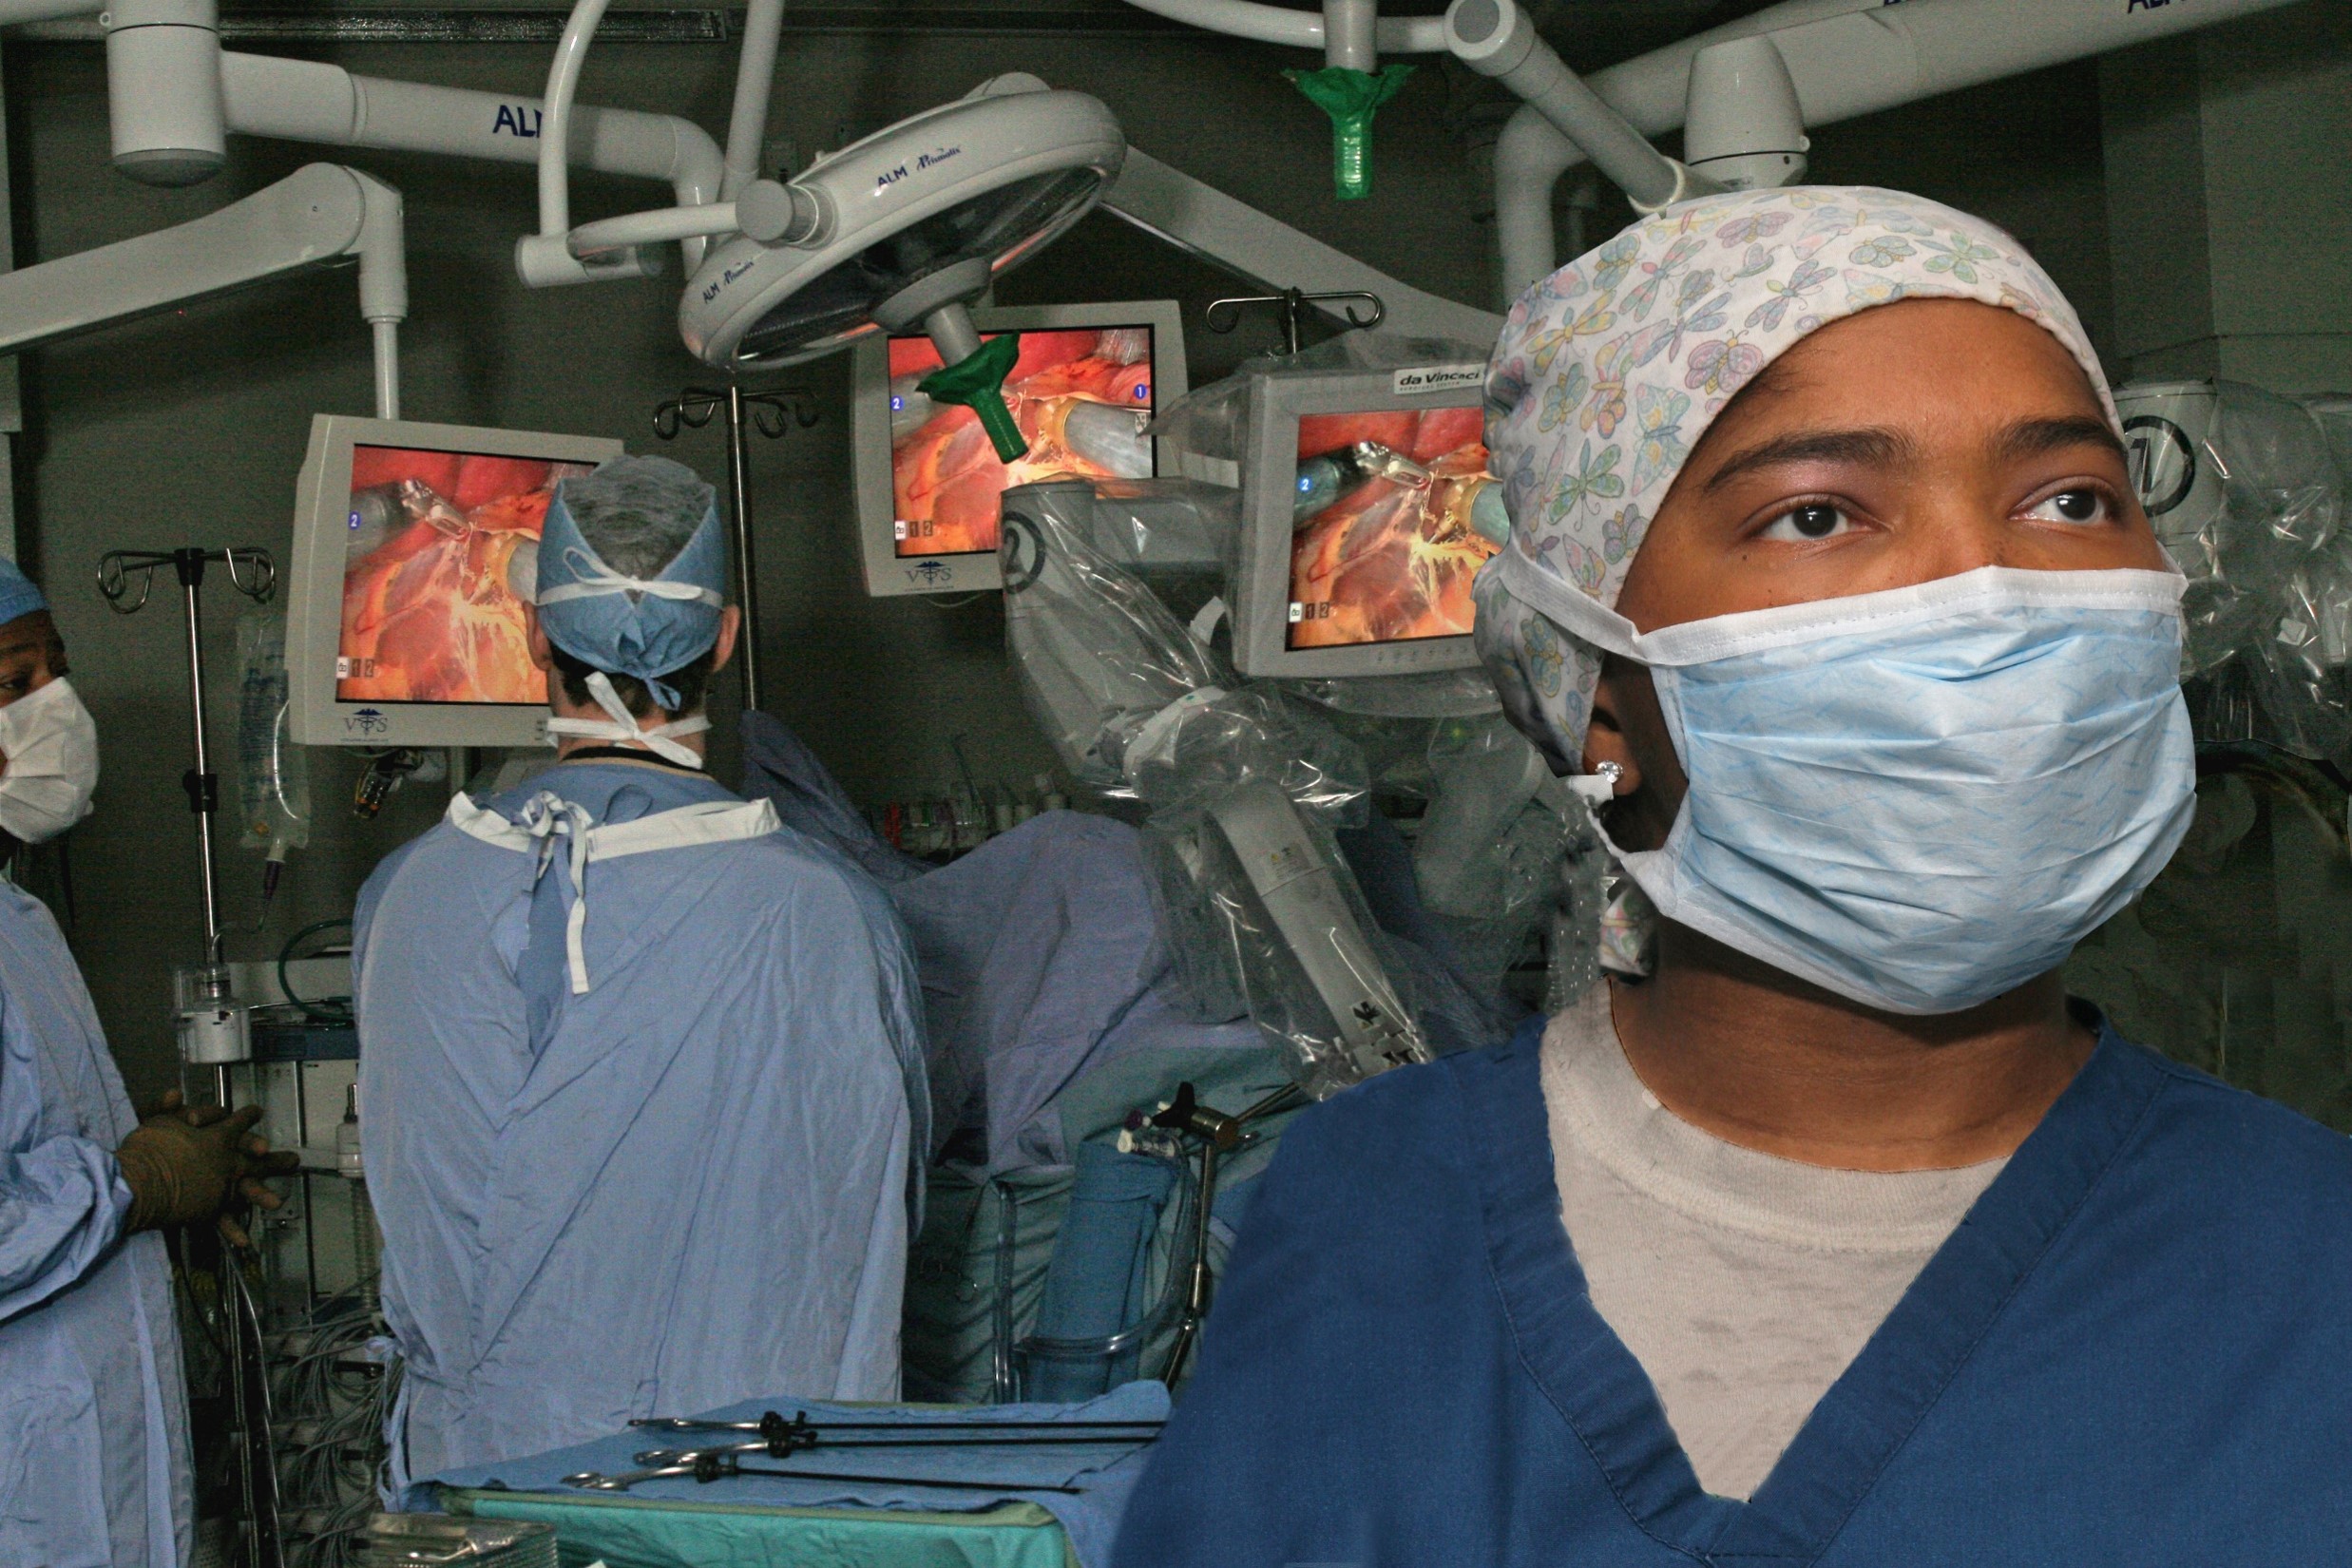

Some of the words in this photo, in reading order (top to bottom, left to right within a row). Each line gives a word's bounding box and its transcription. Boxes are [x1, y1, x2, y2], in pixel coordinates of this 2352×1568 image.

[877, 165, 908, 188] ALM
[702, 281, 720, 304] ALM
[1400, 374, 1423, 386] da
[1301, 478, 1310, 490] 2
